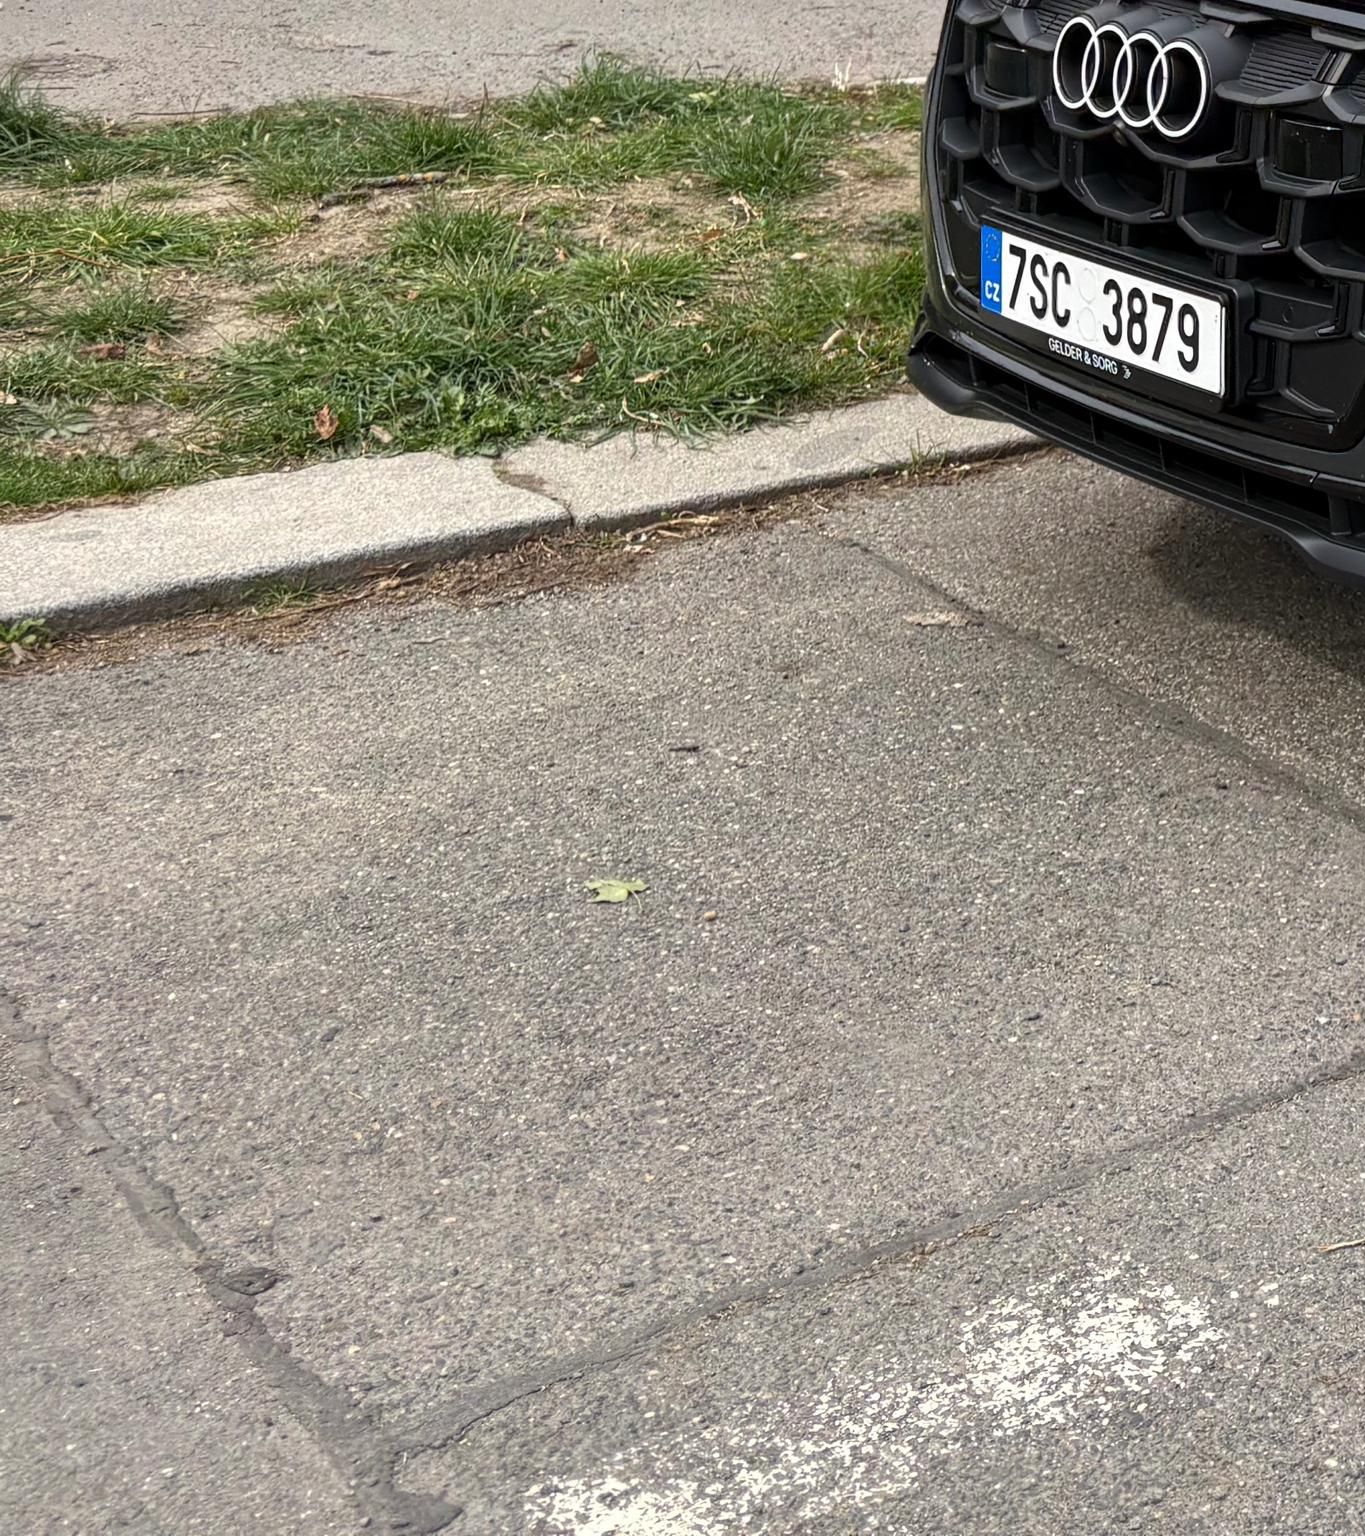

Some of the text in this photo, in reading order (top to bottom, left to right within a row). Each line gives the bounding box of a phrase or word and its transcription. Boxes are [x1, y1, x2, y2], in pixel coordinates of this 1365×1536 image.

[984, 280, 1000, 302] CZ
[1009, 244, 1200, 373] 7SC 3879
[1048, 337, 1118, 375] GELDER & SORG
